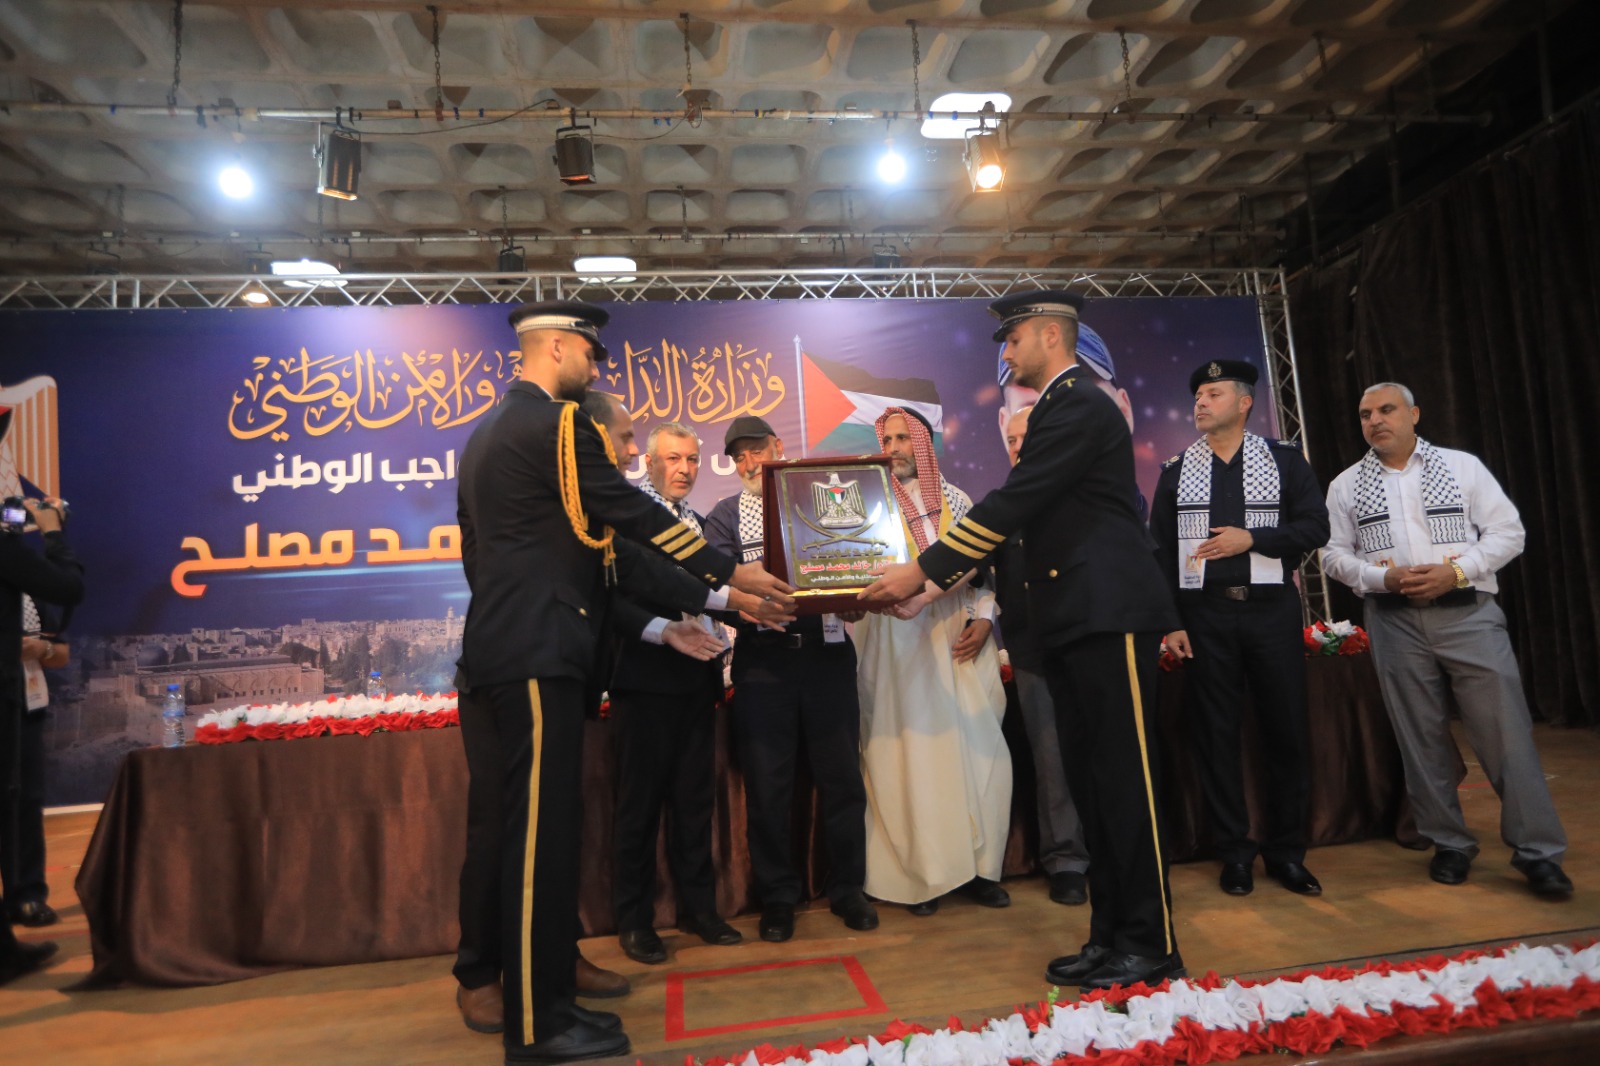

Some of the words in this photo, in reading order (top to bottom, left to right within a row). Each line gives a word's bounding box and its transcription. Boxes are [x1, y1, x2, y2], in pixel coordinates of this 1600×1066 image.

[228, 346, 377, 442] الوطني
[687, 342, 786, 424] وزارة
[232, 452, 372, 503] الوطني
[170, 522, 354, 597] مصلح
[366, 524, 462, 564] مد
